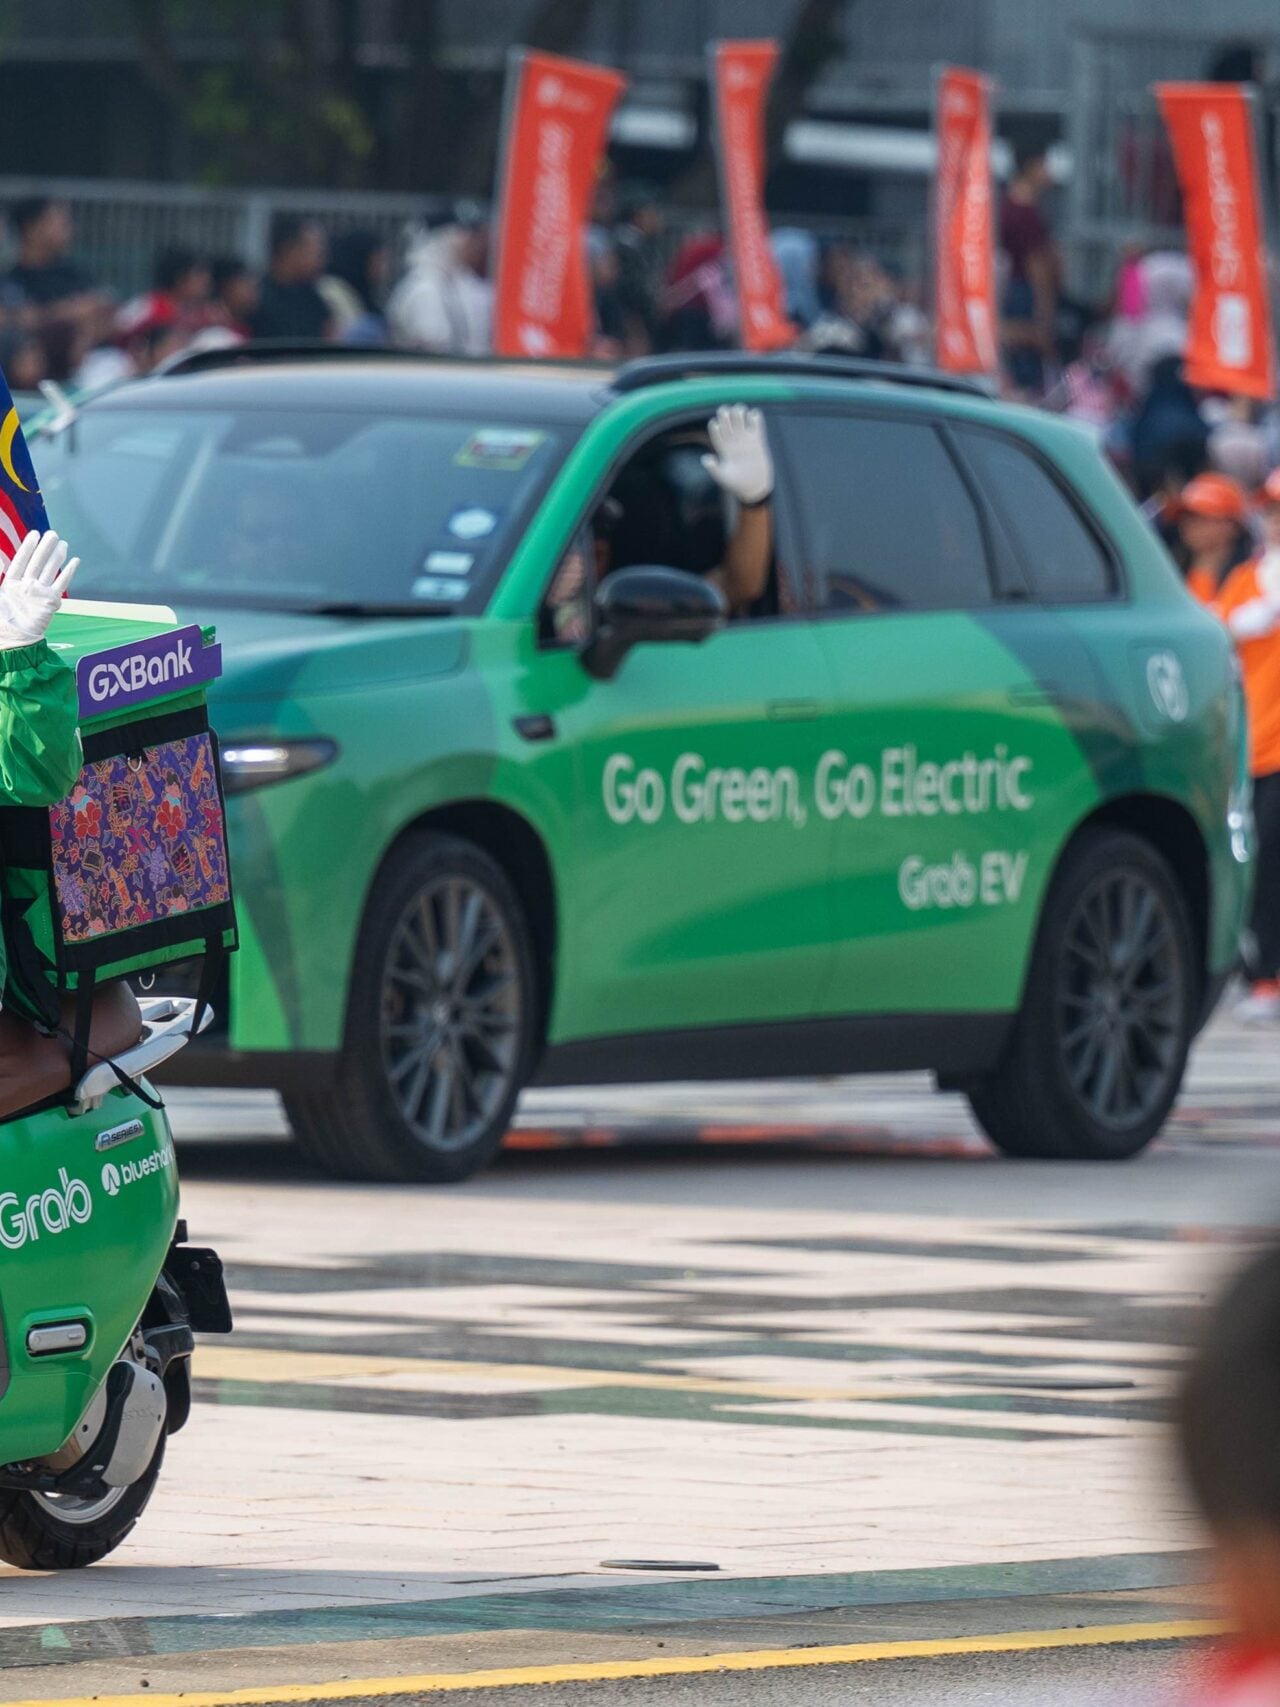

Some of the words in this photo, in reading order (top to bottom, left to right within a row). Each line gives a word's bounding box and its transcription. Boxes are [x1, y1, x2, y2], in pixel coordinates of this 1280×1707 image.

[87, 639, 195, 702] GXBank
[603, 754, 664, 824] Go
[672, 753, 806, 829] Green,
[815, 749, 875, 820] Go
[880, 744, 1034, 817] Electric
[898, 849, 976, 910] Grab
[981, 851, 1028, 905] EV
[111, 1125, 139, 1142] SERIES
